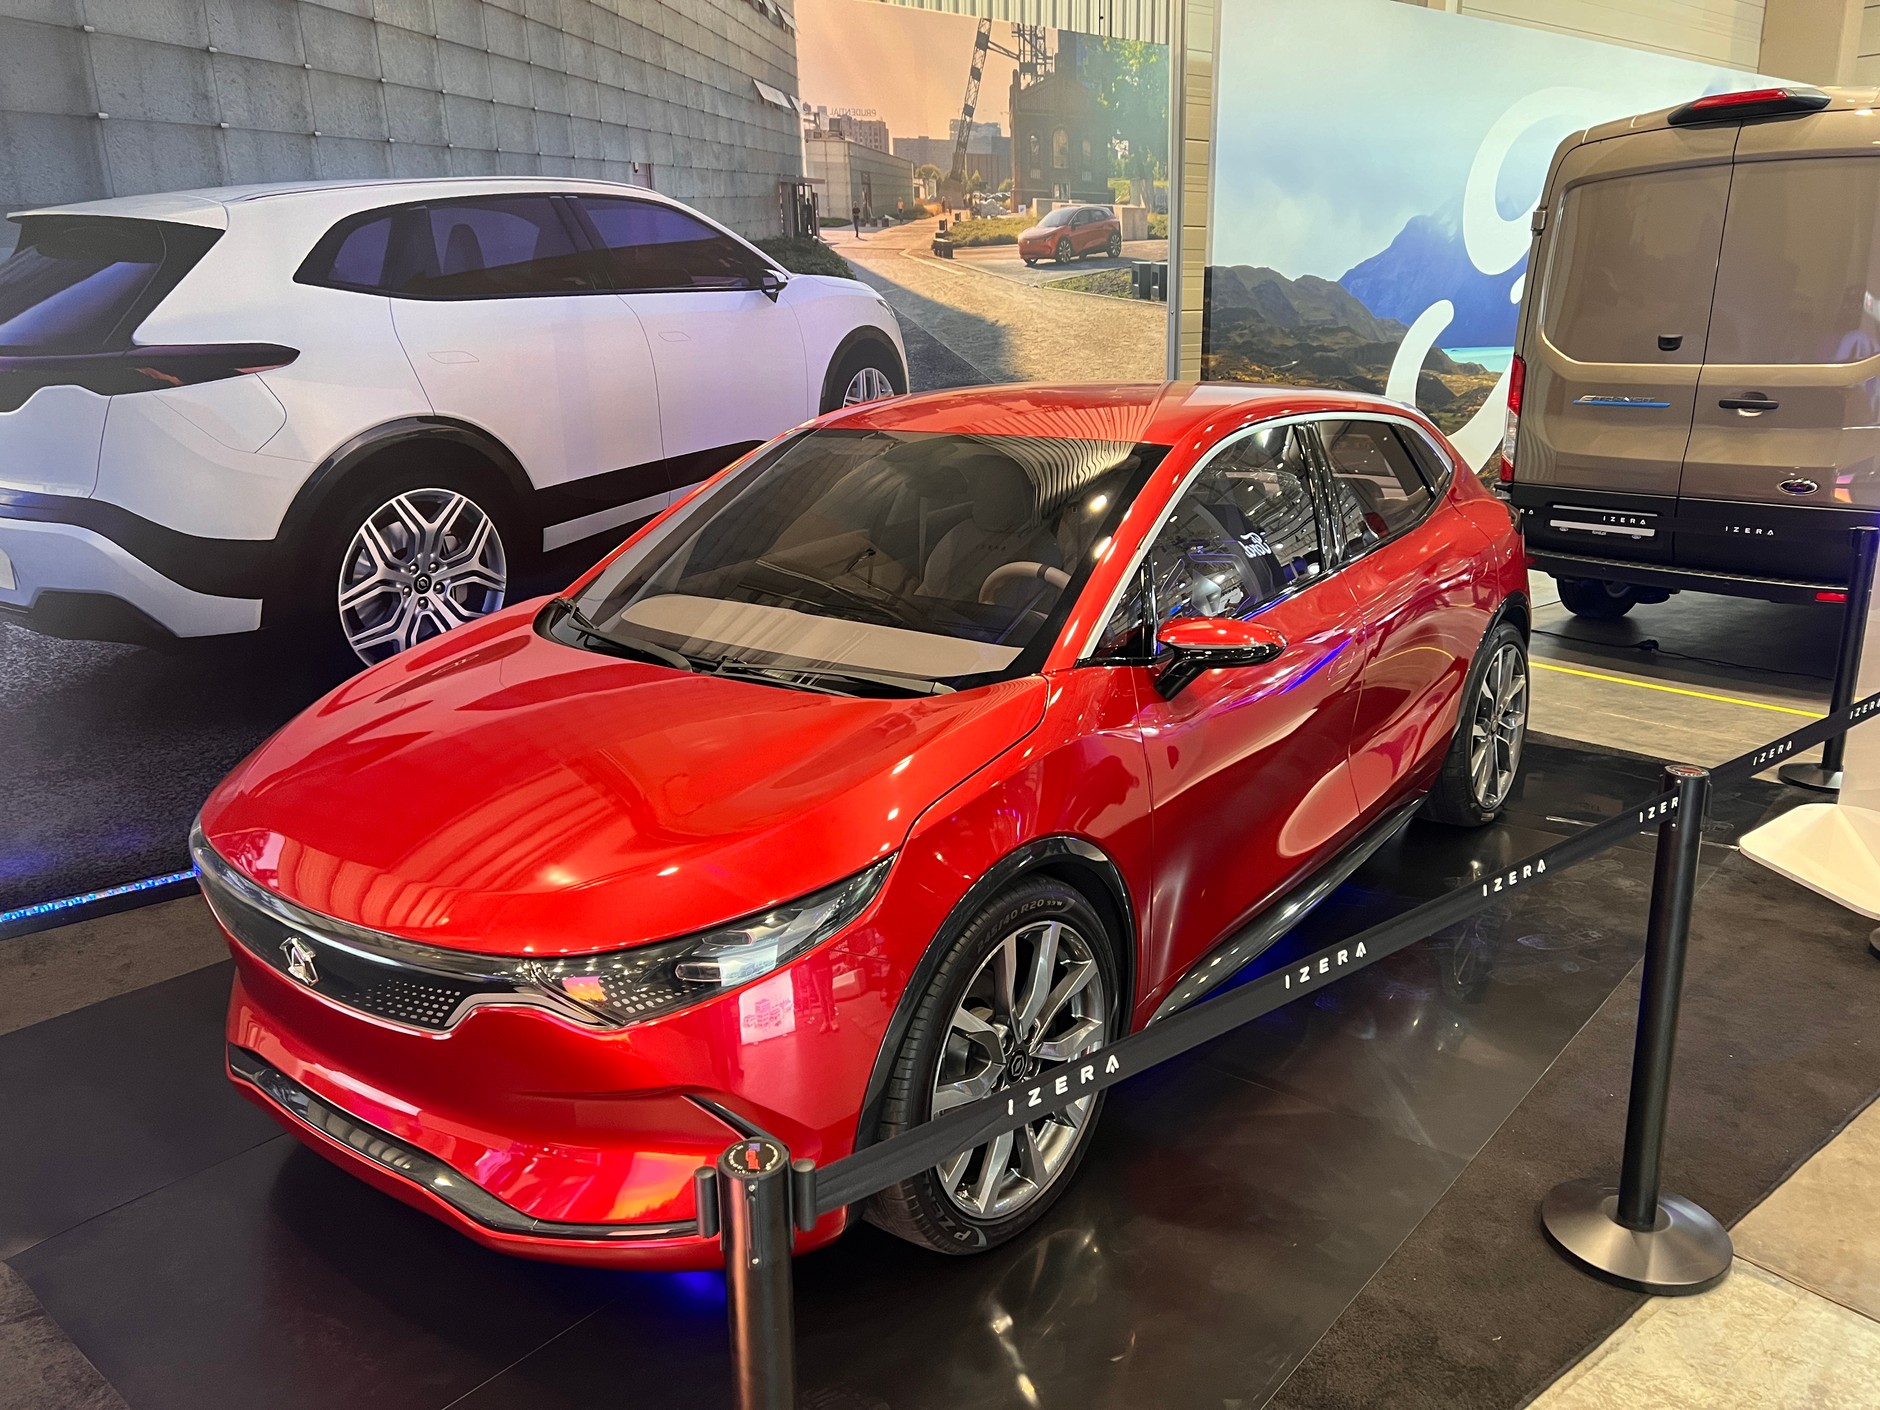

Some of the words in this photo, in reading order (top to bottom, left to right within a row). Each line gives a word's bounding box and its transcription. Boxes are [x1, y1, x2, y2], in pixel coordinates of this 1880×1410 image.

[1603, 515, 1647, 526] IZERA
[1725, 526, 1775, 536] IZERA
[1752, 740, 1793, 766] IZERA
[1639, 796, 1679, 823] IZER
[1482, 859, 1546, 897] IZERA
[1020, 899, 1045, 914] R20
[1285, 941, 1367, 989] IZERA
[1008, 1055, 1120, 1116] IZERA
